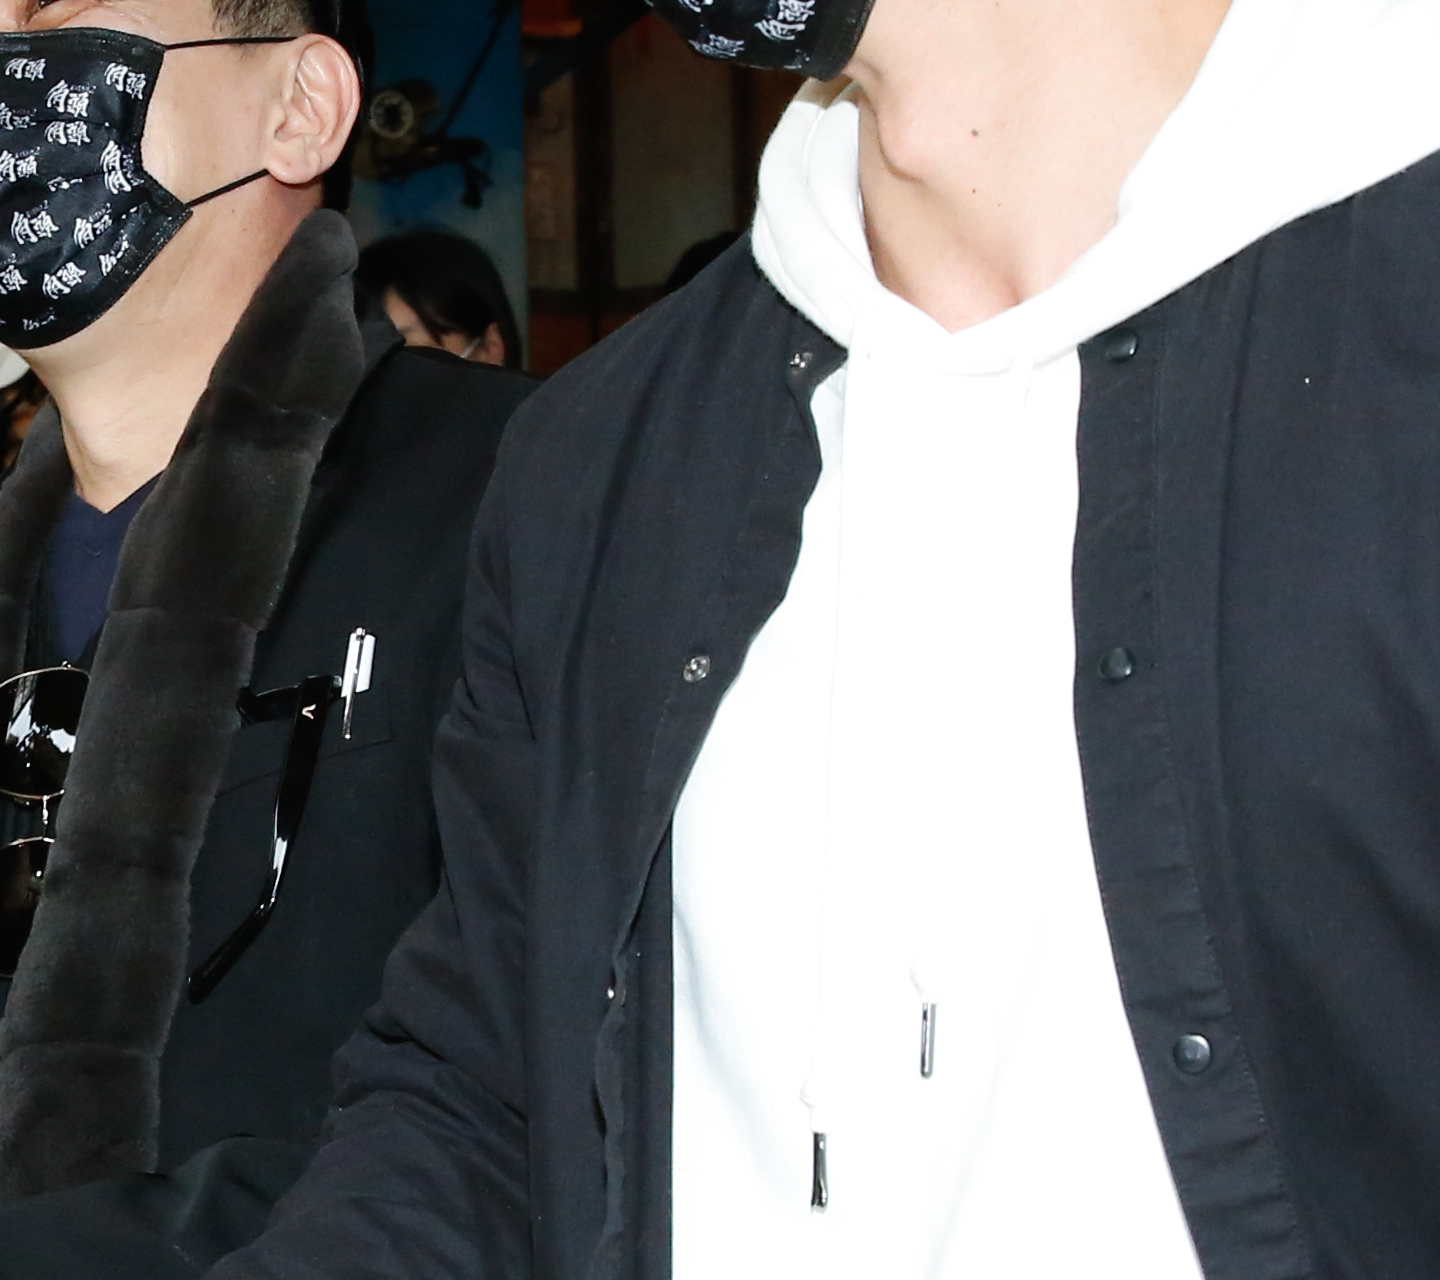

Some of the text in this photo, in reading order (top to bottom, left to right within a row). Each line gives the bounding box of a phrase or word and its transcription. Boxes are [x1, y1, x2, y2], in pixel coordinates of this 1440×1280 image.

[5, 58, 46, 80] 角頭
[104, 63, 146, 99] 角頭
[45, 80, 90, 117] 角頭
[11, 211, 59, 244] 角頭
